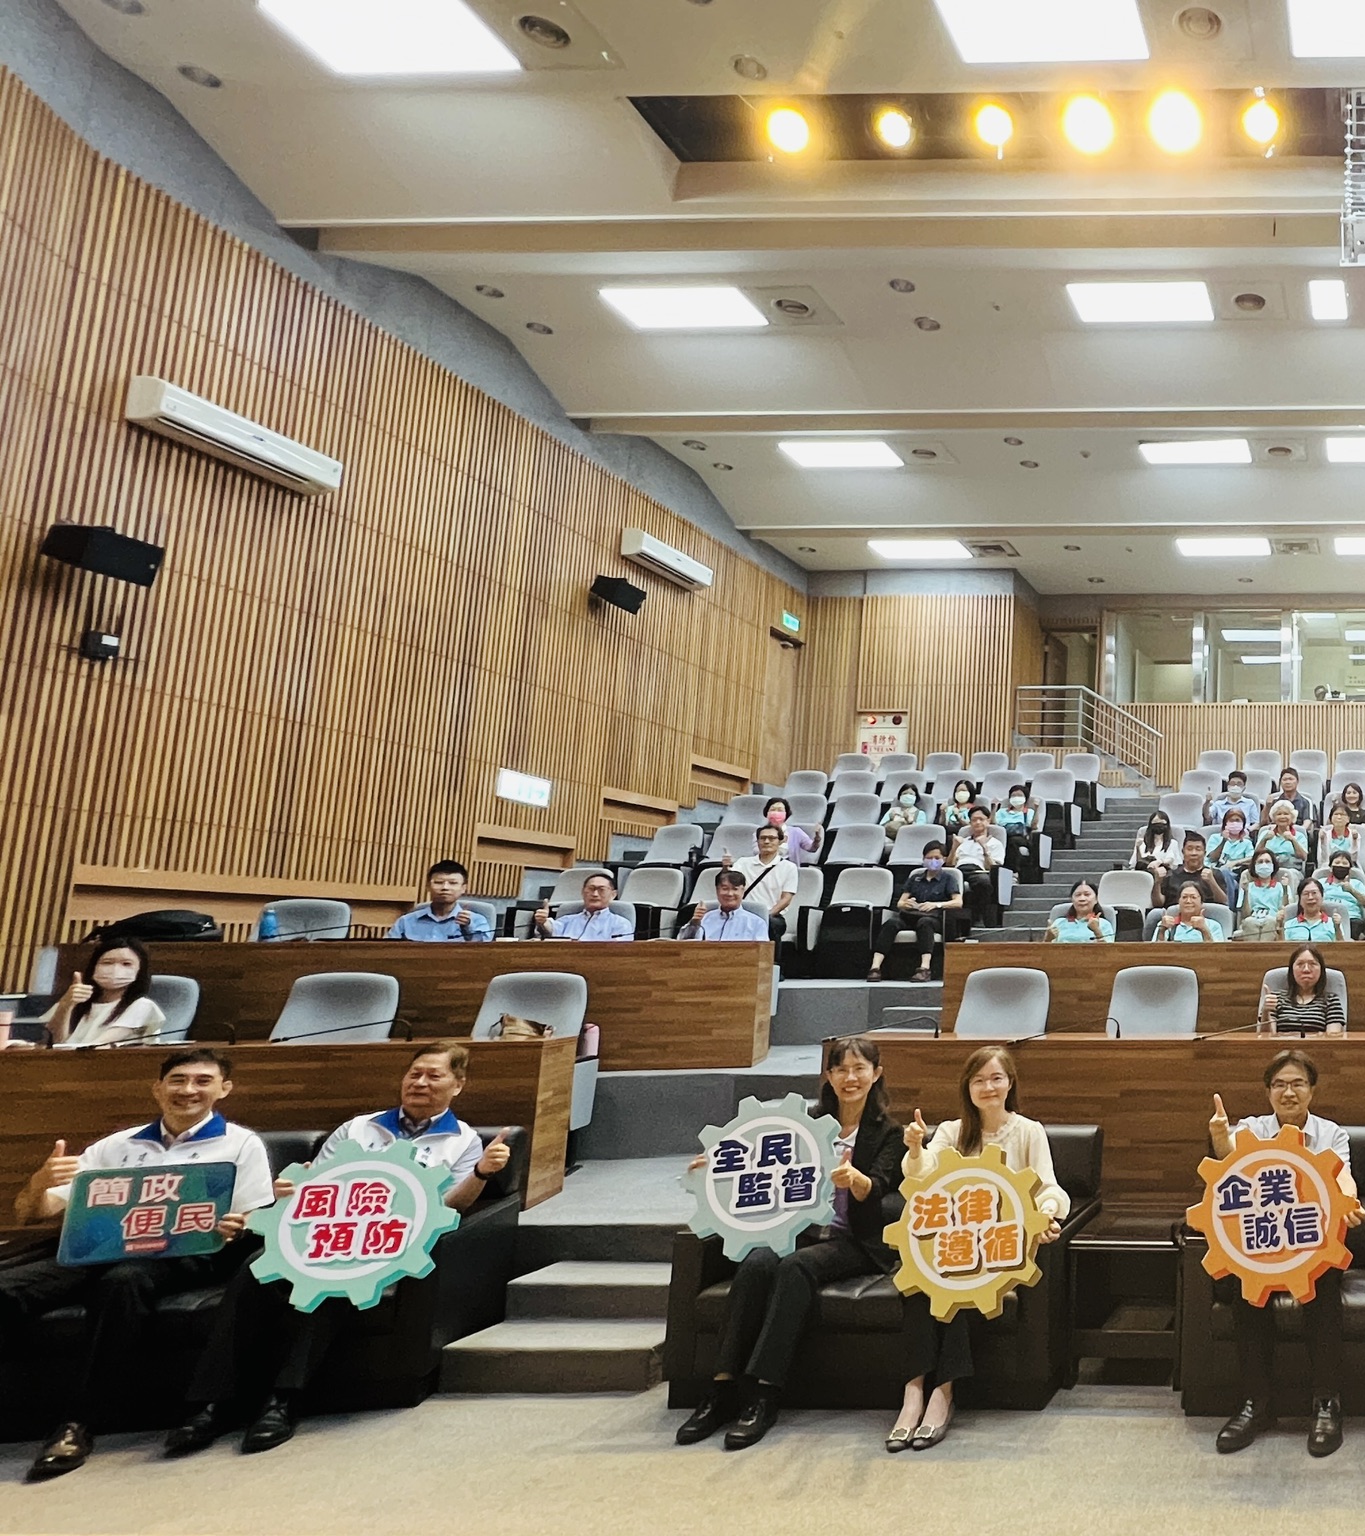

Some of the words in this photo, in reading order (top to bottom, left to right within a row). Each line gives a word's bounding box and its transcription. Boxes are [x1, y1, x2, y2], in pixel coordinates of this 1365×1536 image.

[712, 1132, 793, 1174] 全民
[87, 1172, 184, 1208] 簡政
[292, 1181, 392, 1220] 風險
[735, 1165, 817, 1209] 監督
[1217, 1168, 1296, 1212] 企業
[120, 1201, 217, 1240] 便民
[912, 1186, 996, 1230] 法律
[1243, 1206, 1321, 1251] 誠信
[307, 1219, 408, 1260] 預防
[937, 1228, 1019, 1269] 遵循
